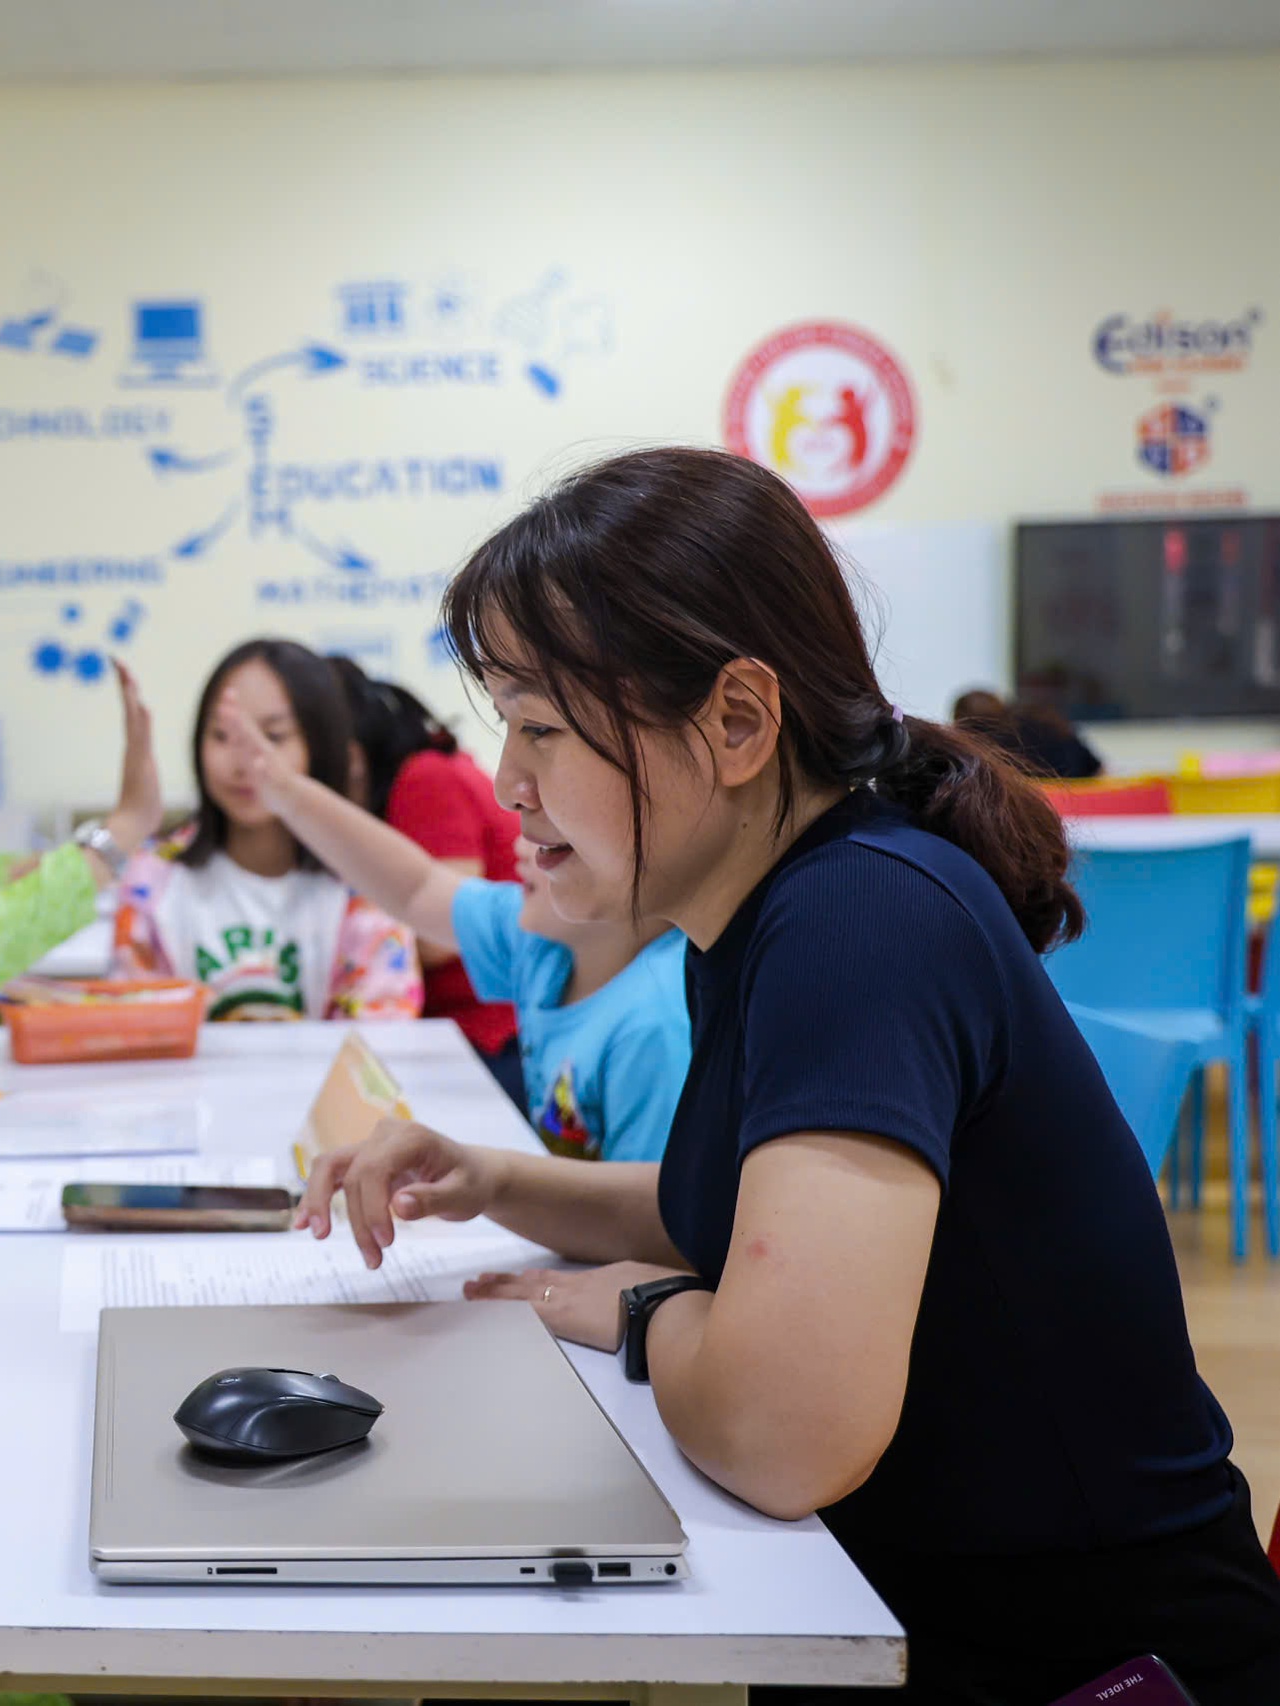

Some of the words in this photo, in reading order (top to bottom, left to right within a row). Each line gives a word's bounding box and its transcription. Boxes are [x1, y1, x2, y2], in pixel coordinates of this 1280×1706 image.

[363, 357, 499, 385] SCIENCE
[257, 573, 446, 603] MATHEMAT
[1124, 1673, 1144, 1687] THE
[1096, 1683, 1124, 1700] IDEAL
